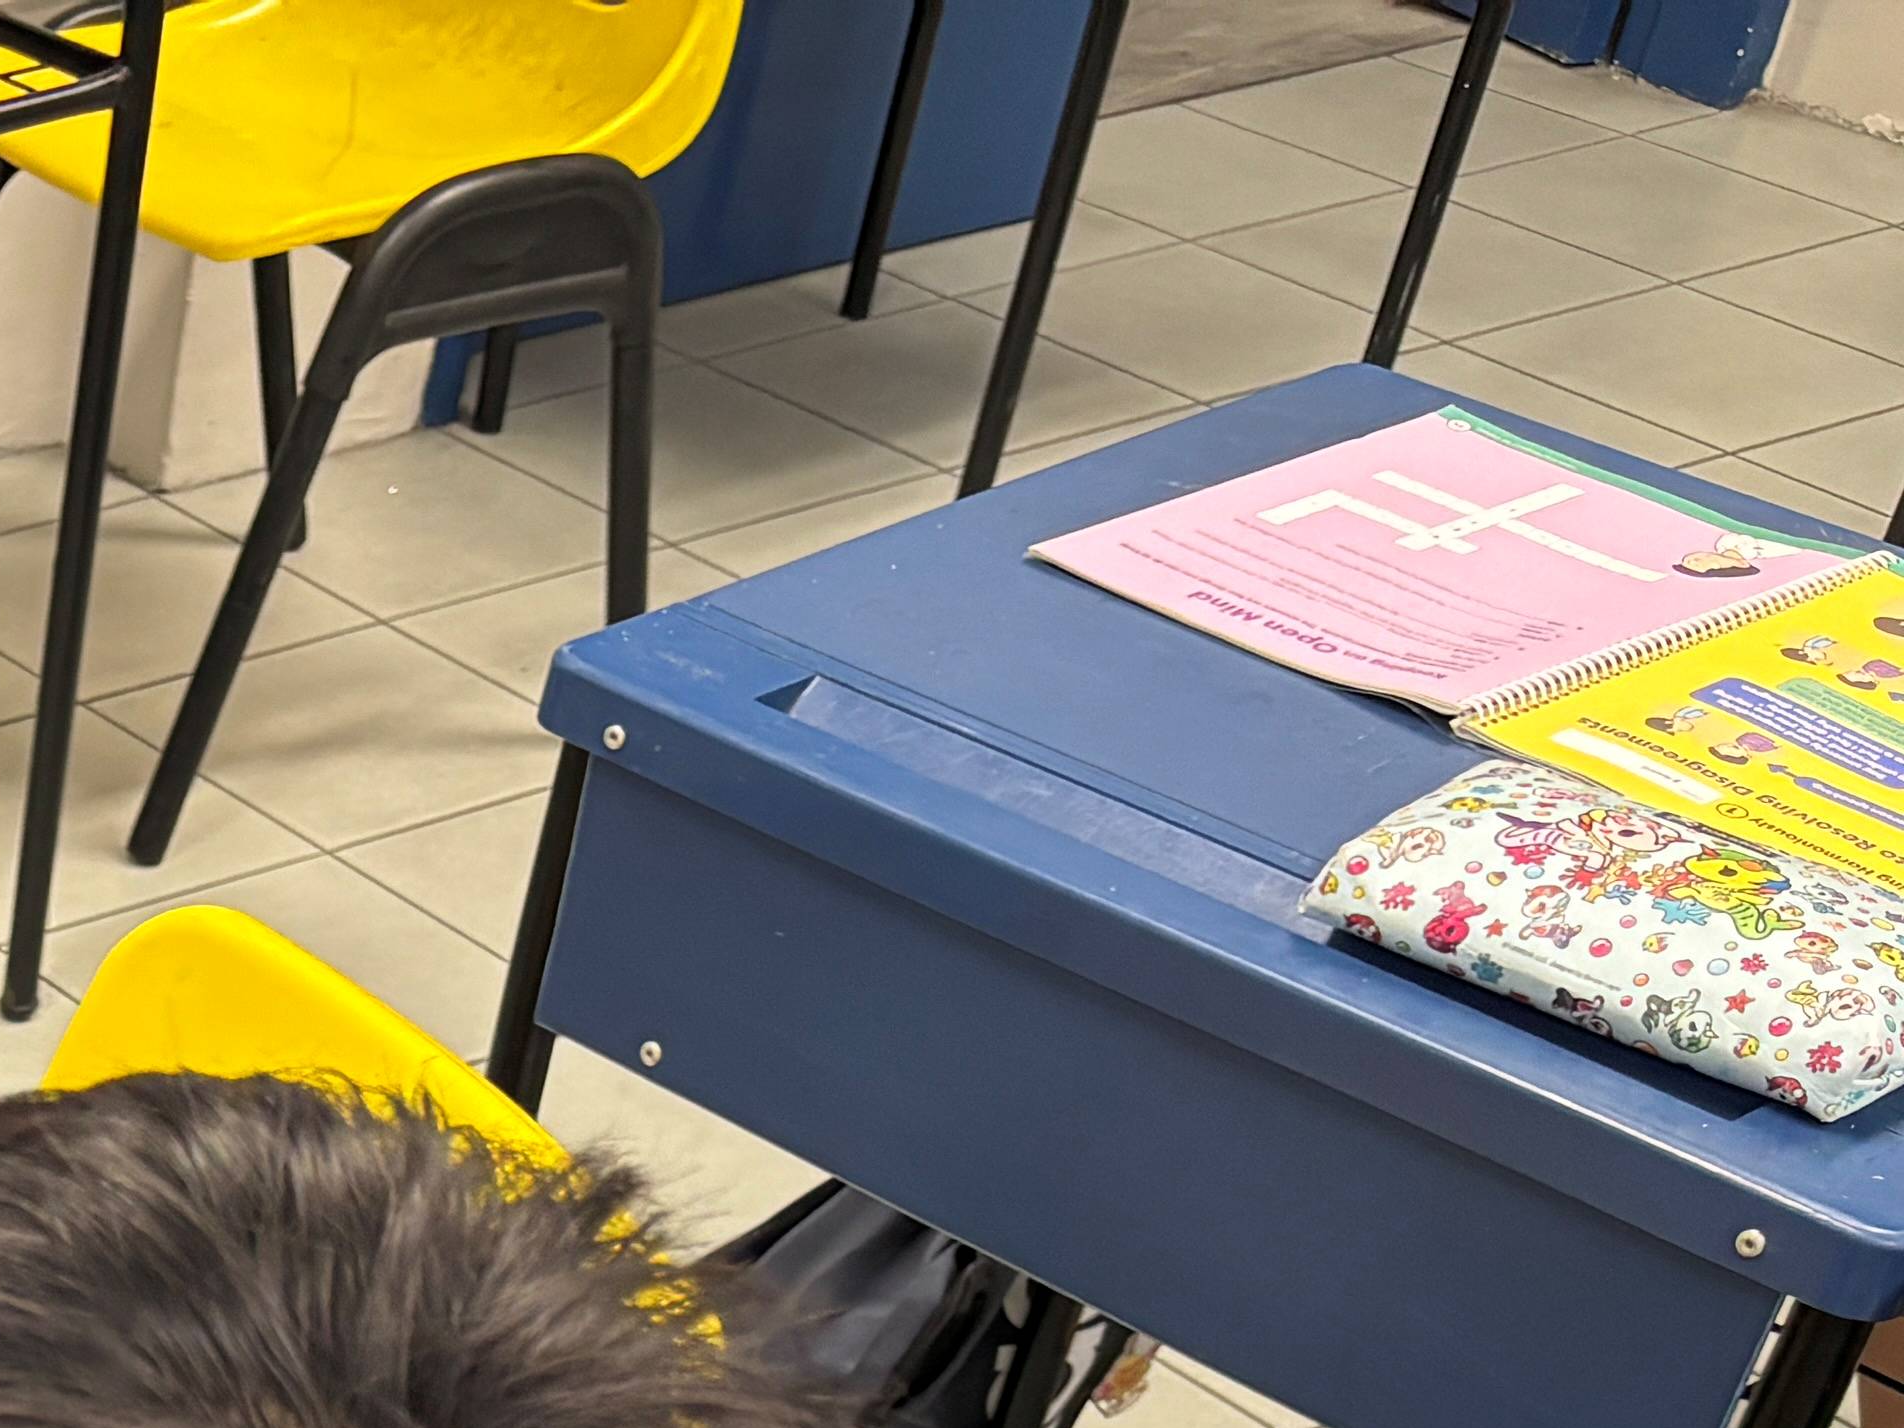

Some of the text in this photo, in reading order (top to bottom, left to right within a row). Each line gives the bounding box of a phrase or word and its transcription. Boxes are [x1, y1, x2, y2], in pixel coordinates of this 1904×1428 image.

[1187, 589, 1339, 654] Open Mind
[1576, 716, 1754, 797] Disagreements
[1747, 816, 1876, 876] Harmoniously
[1755, 794, 1877, 851] Resolving
